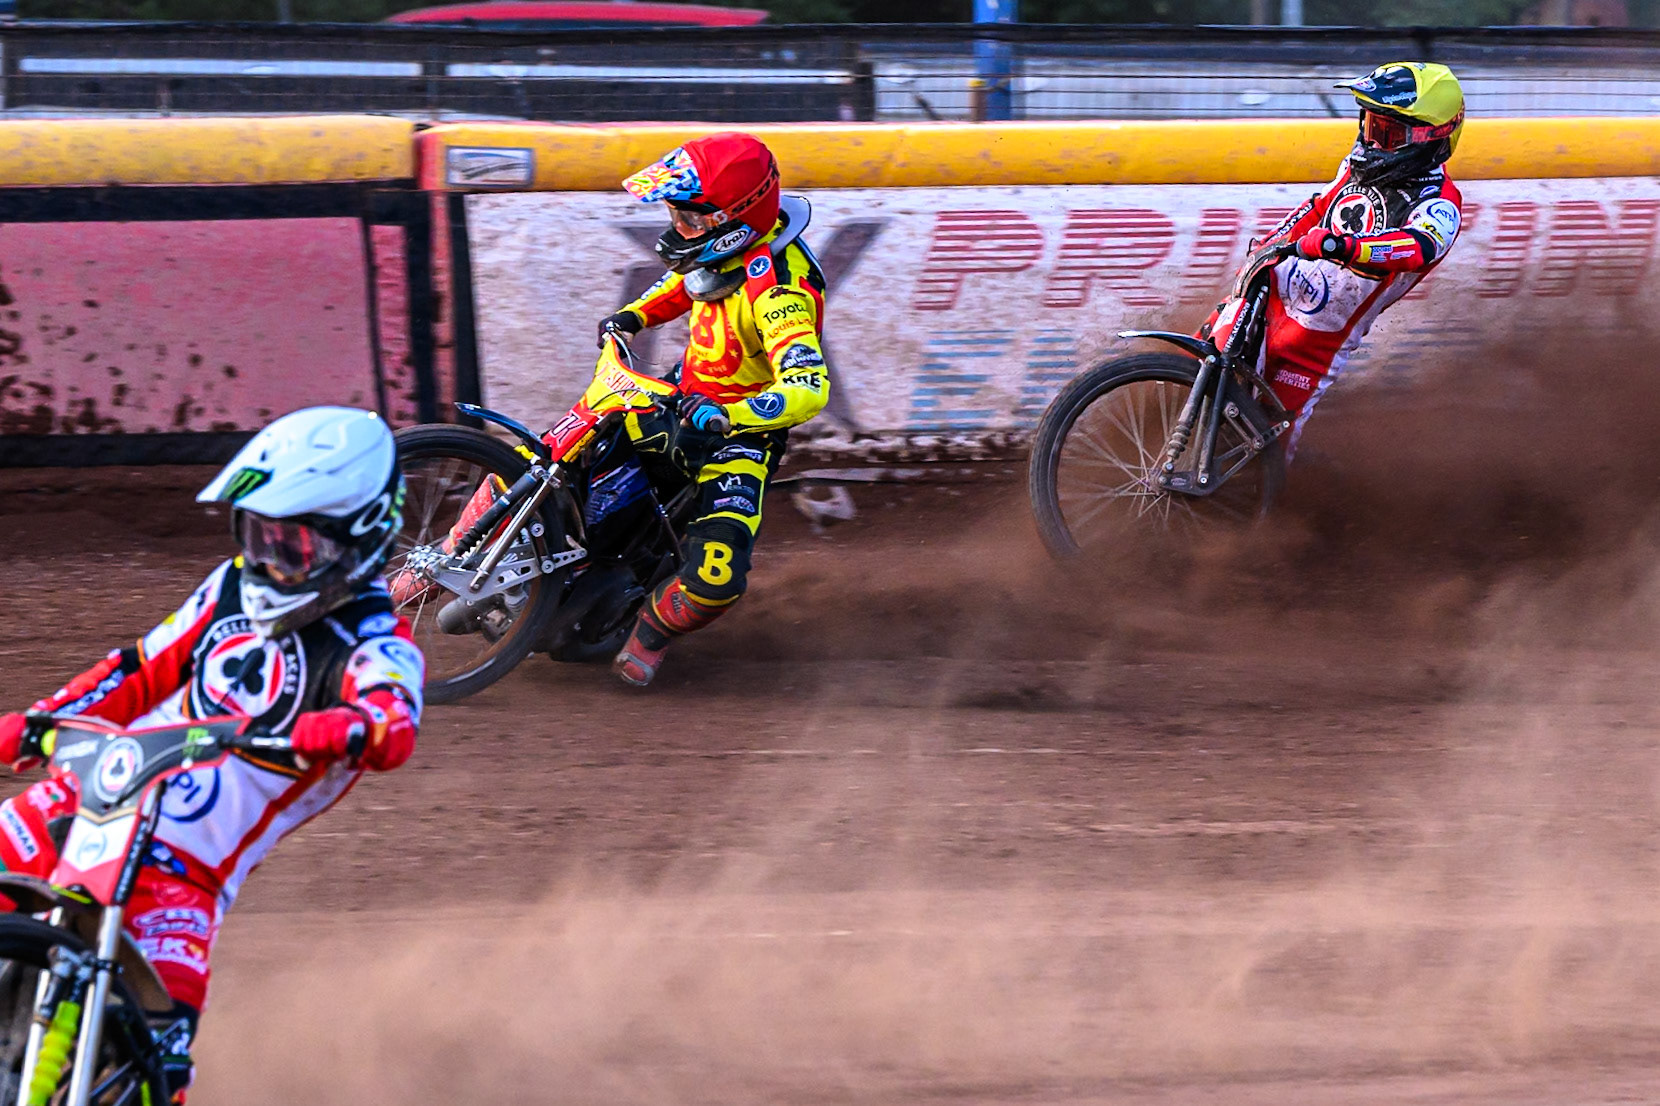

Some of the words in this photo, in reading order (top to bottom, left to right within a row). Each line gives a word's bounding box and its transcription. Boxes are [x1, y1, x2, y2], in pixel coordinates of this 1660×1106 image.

[1342, 185, 1366, 196] BELLE
[1367, 188, 1381, 206] VUE
[1375, 209, 1384, 234] ACES
[717, 232, 747, 249] Arai
[768, 318, 796, 339] Louis
[697, 541, 733, 586] B
